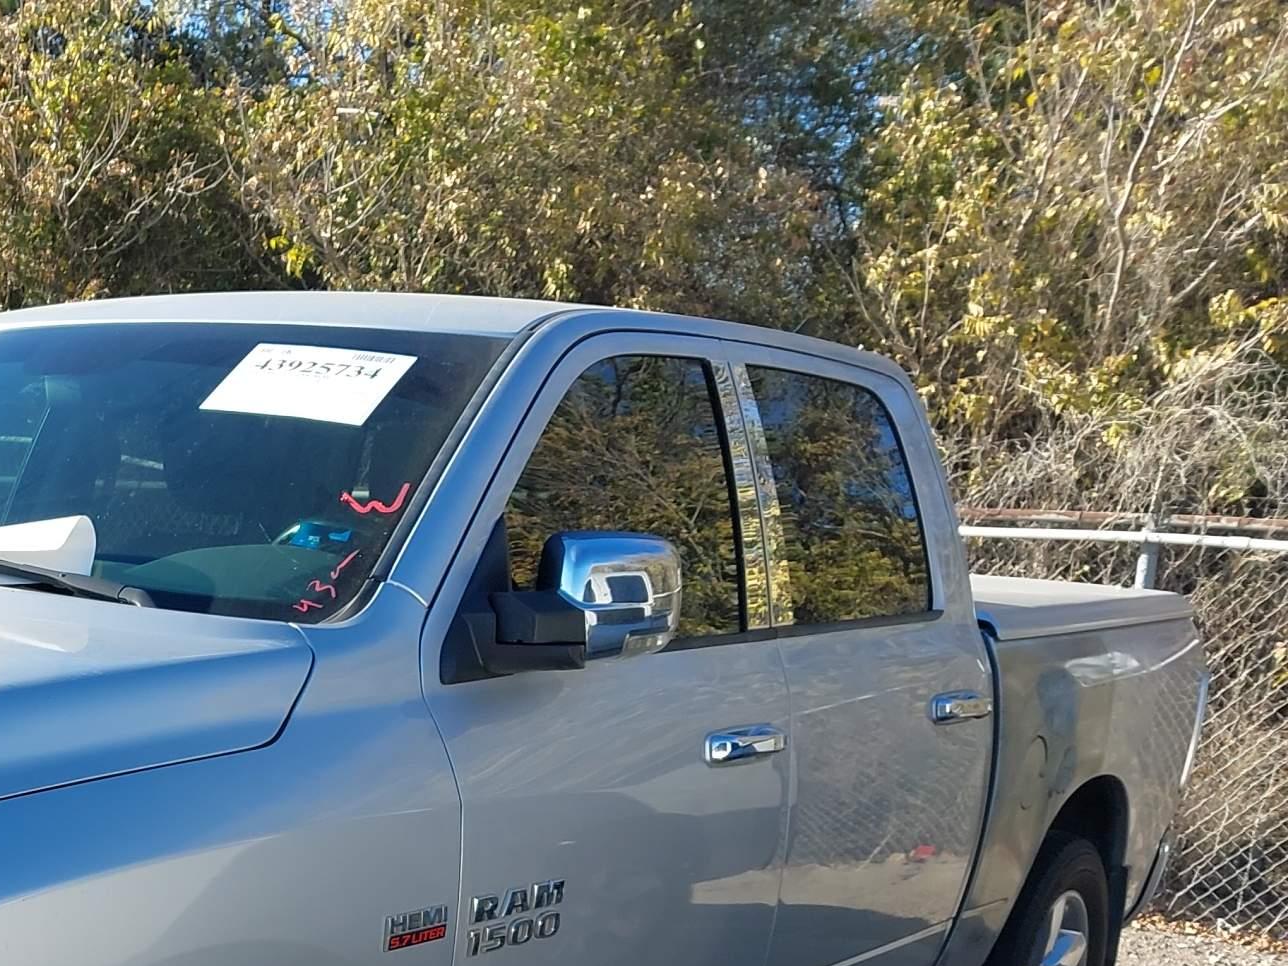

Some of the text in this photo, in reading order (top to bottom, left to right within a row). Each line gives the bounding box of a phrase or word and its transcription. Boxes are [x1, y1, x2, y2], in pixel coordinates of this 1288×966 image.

[255, 357, 383, 380] 43925734
[469, 879, 566, 925] RAM
[386, 904, 449, 935] HEMI
[466, 909, 562, 958] 1500
[411, 928, 446, 945] LITER
